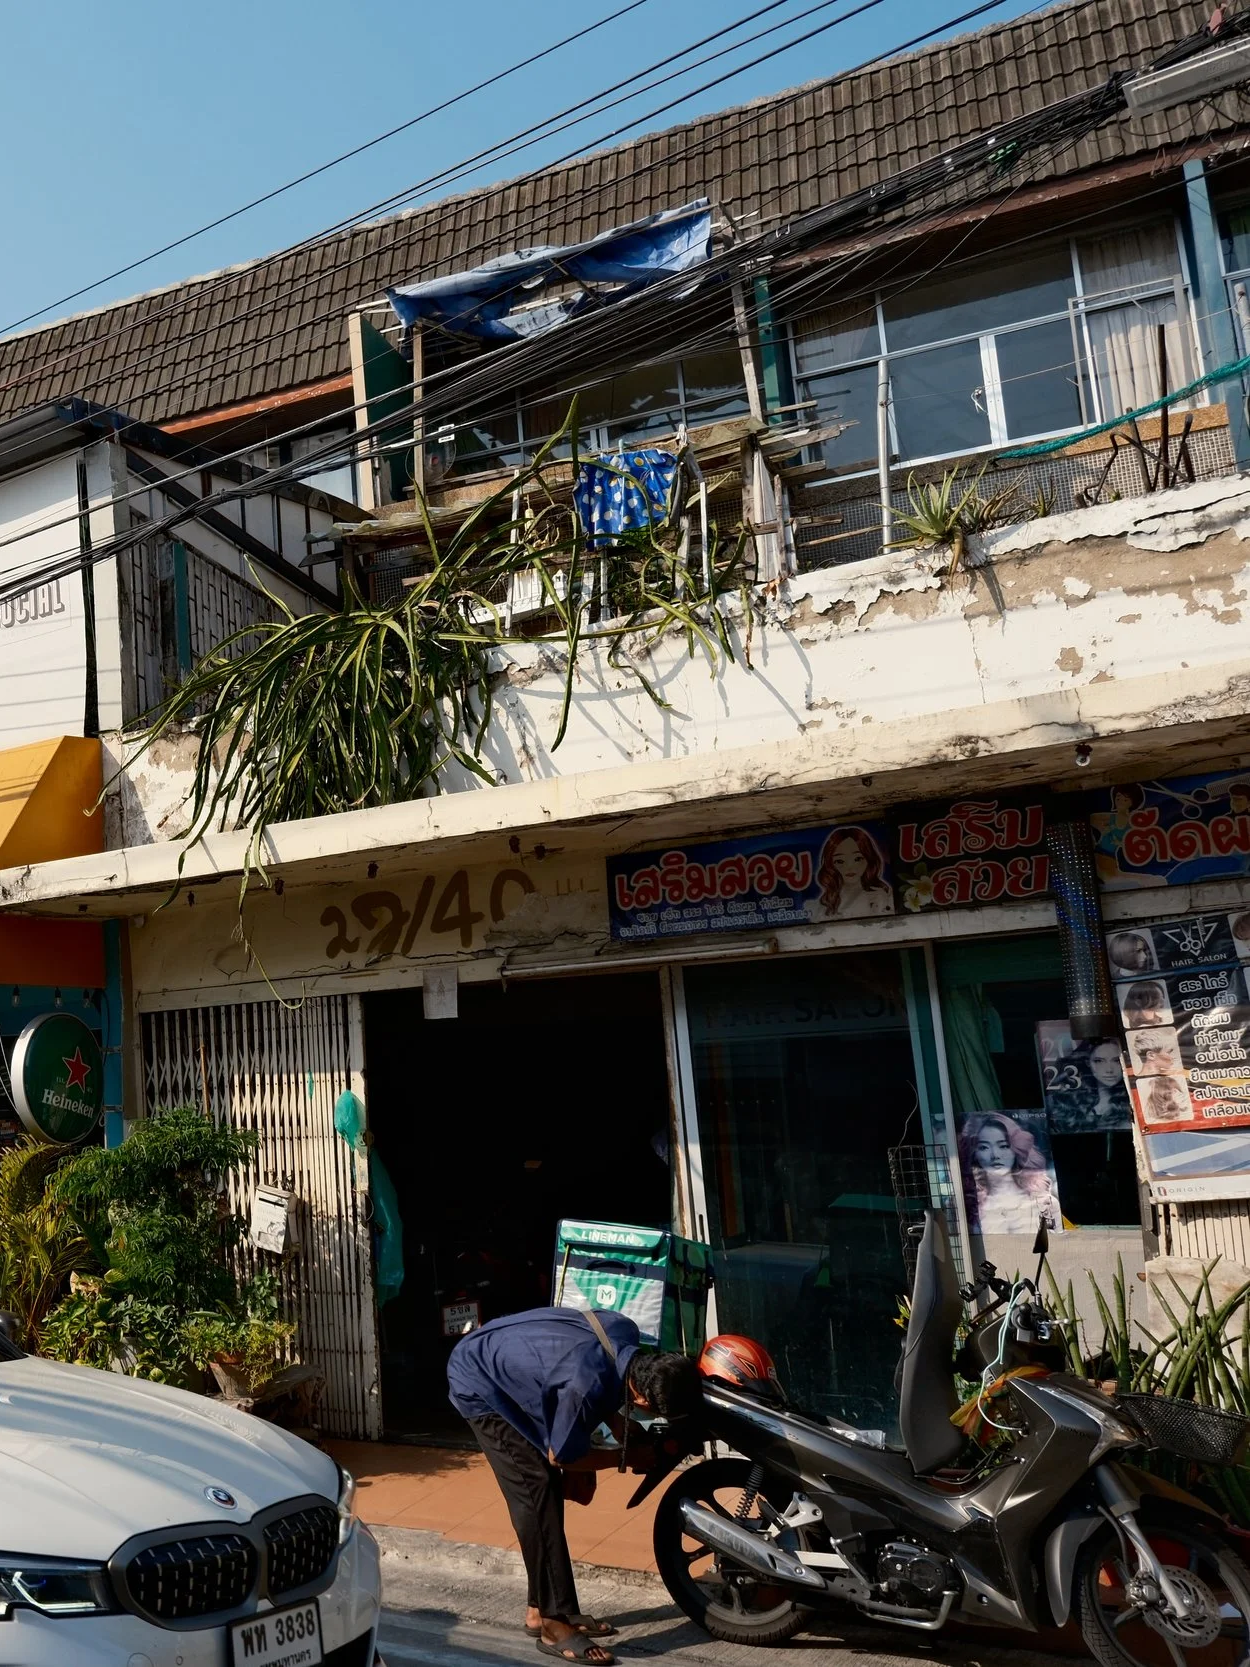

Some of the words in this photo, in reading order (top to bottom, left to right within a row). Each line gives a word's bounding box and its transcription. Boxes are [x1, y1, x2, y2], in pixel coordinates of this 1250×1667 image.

[899, 800, 1044, 863] เสริม
[615, 851, 812, 910] เสริมสวย
[932, 854, 1050, 906] สวย
[1171, 959, 1194, 968] HAIR
[1198, 953, 1227, 964] SALON
[1179, 981, 1202, 993] สระ
[1199, 971, 1228, 990] ไดร์
[1043, 1064, 1082, 1091] 23
[42, 1088, 94, 1118] Heineken
[275, 1609, 315, 1646] 3838
